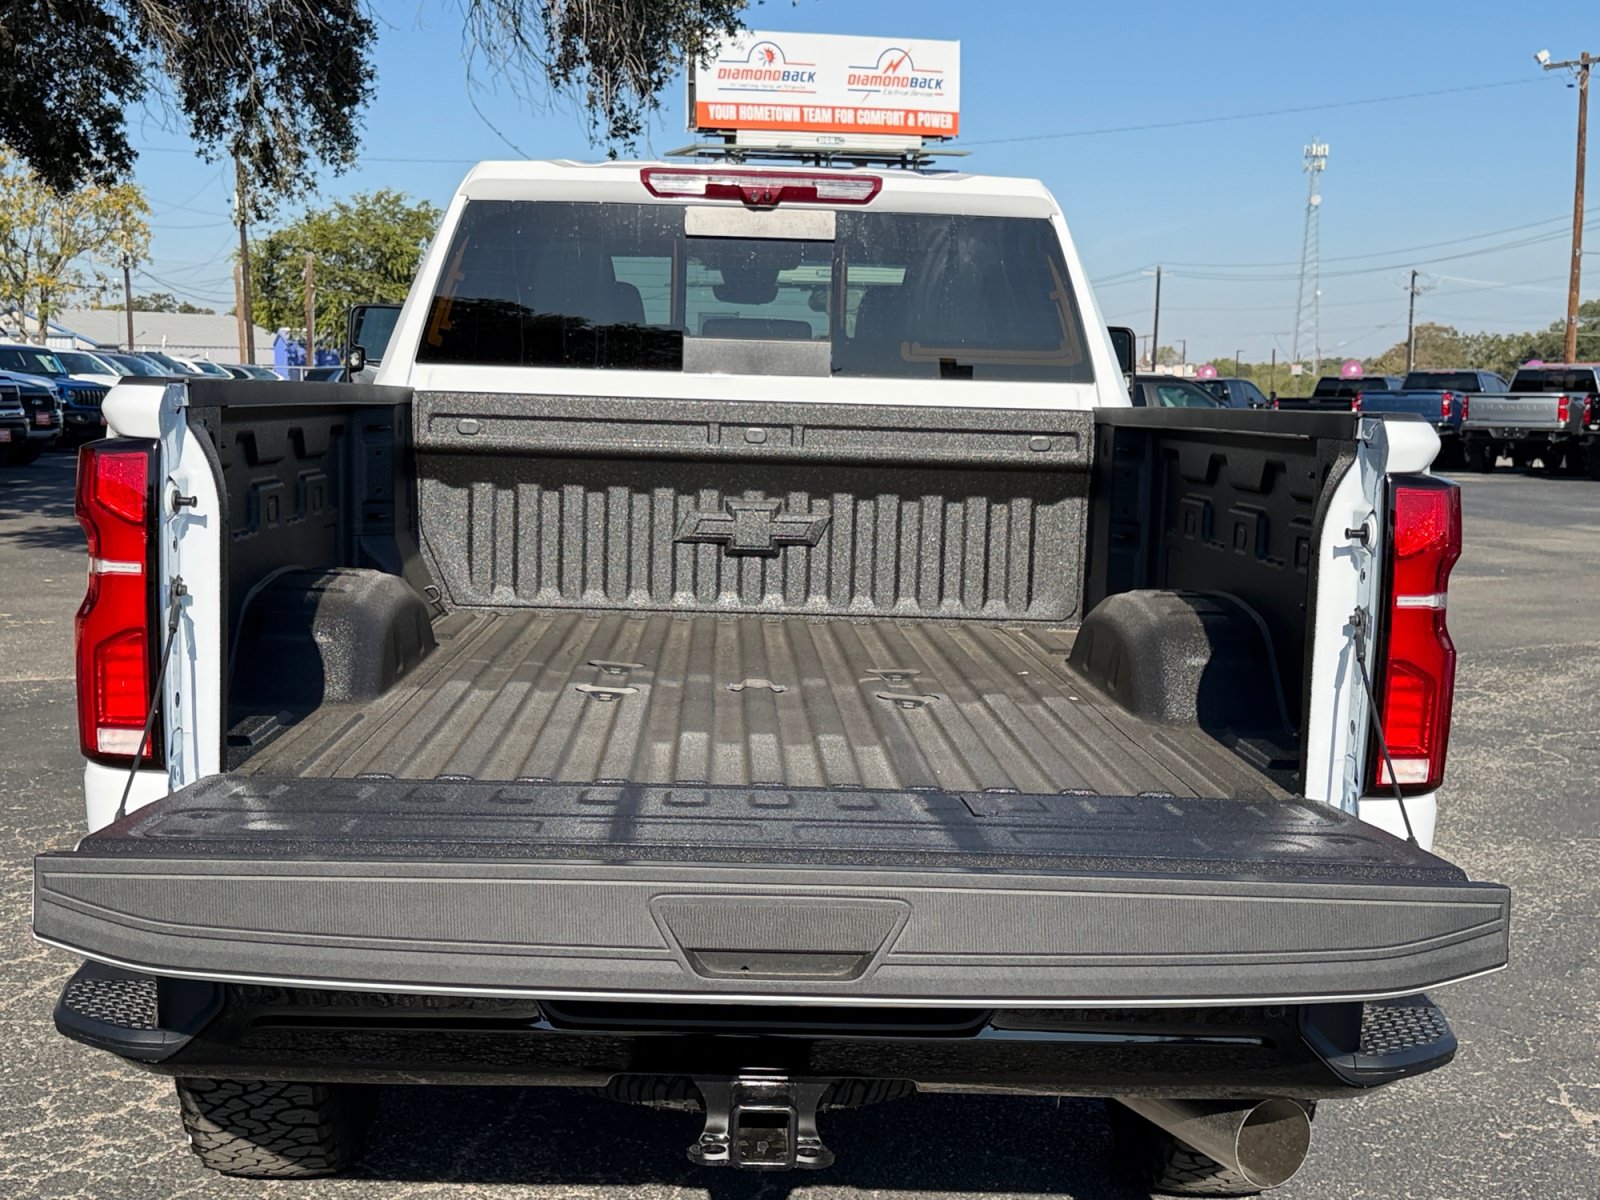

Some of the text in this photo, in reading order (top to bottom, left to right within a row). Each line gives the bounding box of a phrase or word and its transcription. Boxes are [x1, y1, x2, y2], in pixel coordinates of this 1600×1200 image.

[708, 104, 953, 129] YOUR HOMETOWN TEAM FOR COMFORT & POWER
